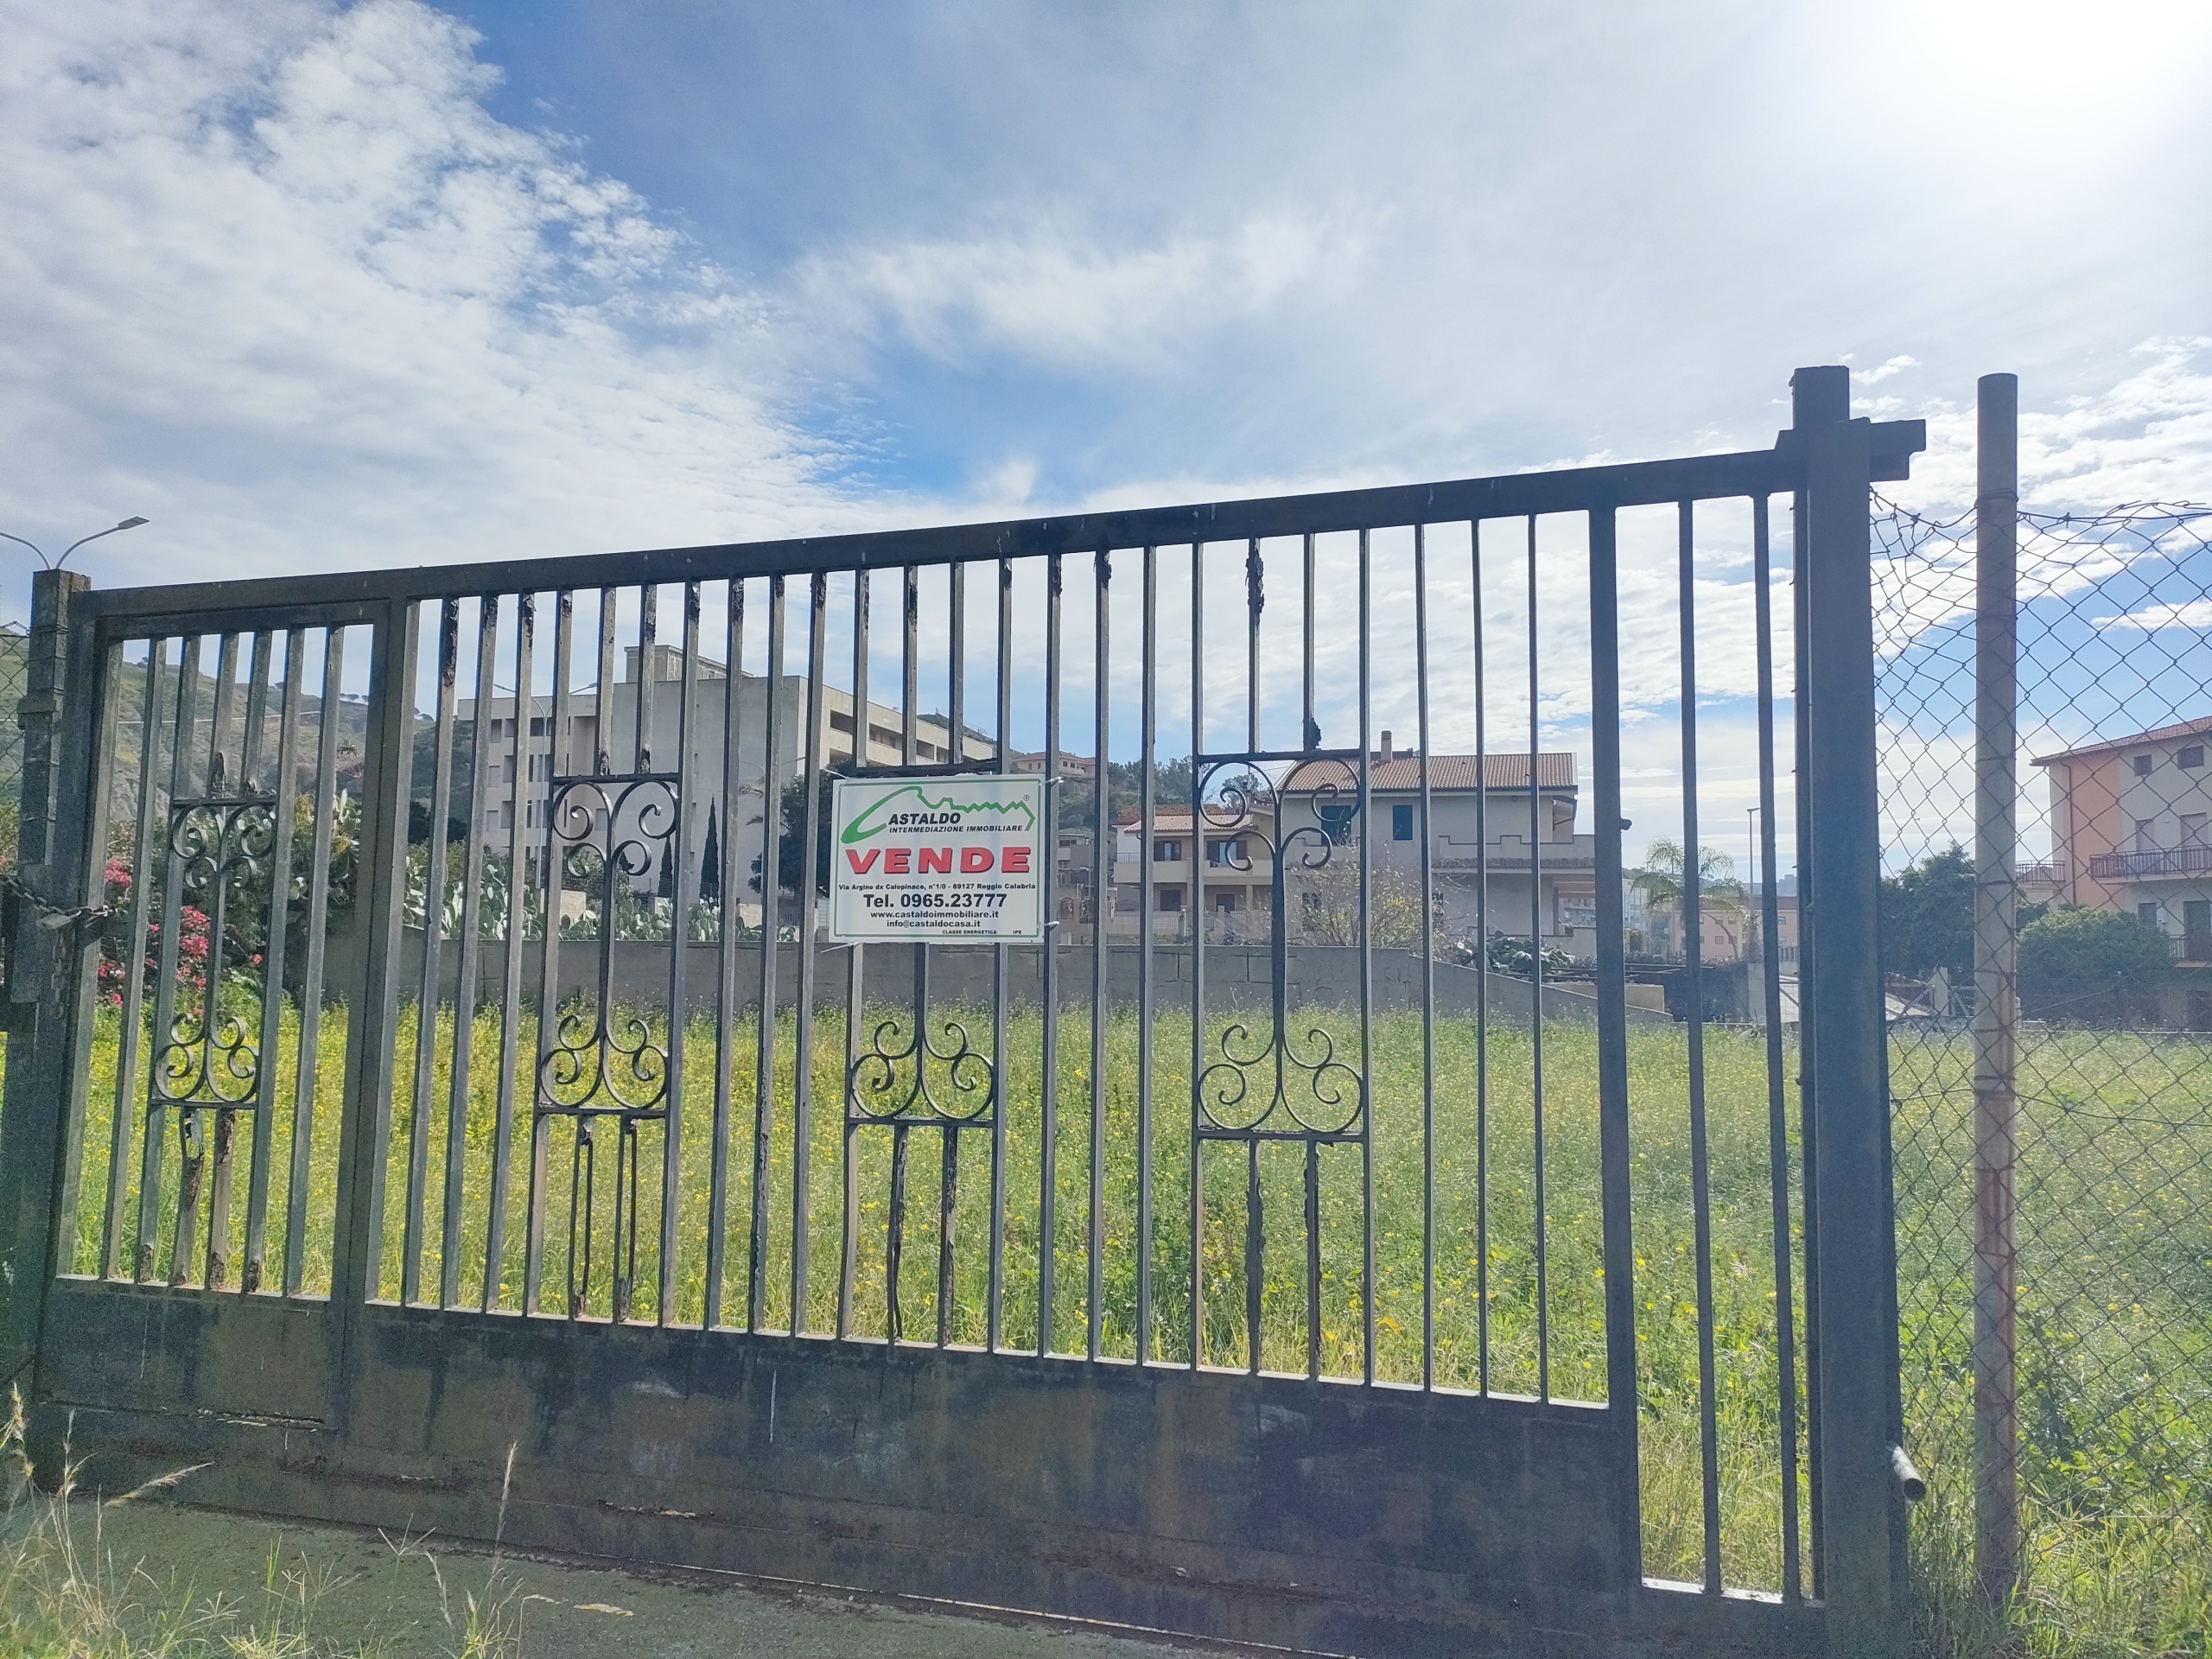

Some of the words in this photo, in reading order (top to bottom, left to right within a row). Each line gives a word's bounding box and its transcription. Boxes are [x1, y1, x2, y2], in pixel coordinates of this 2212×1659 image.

[845, 847, 1032, 874] VENDE
[863, 894, 894, 908] Tel.
[900, 893, 1007, 907] 0965.23777
